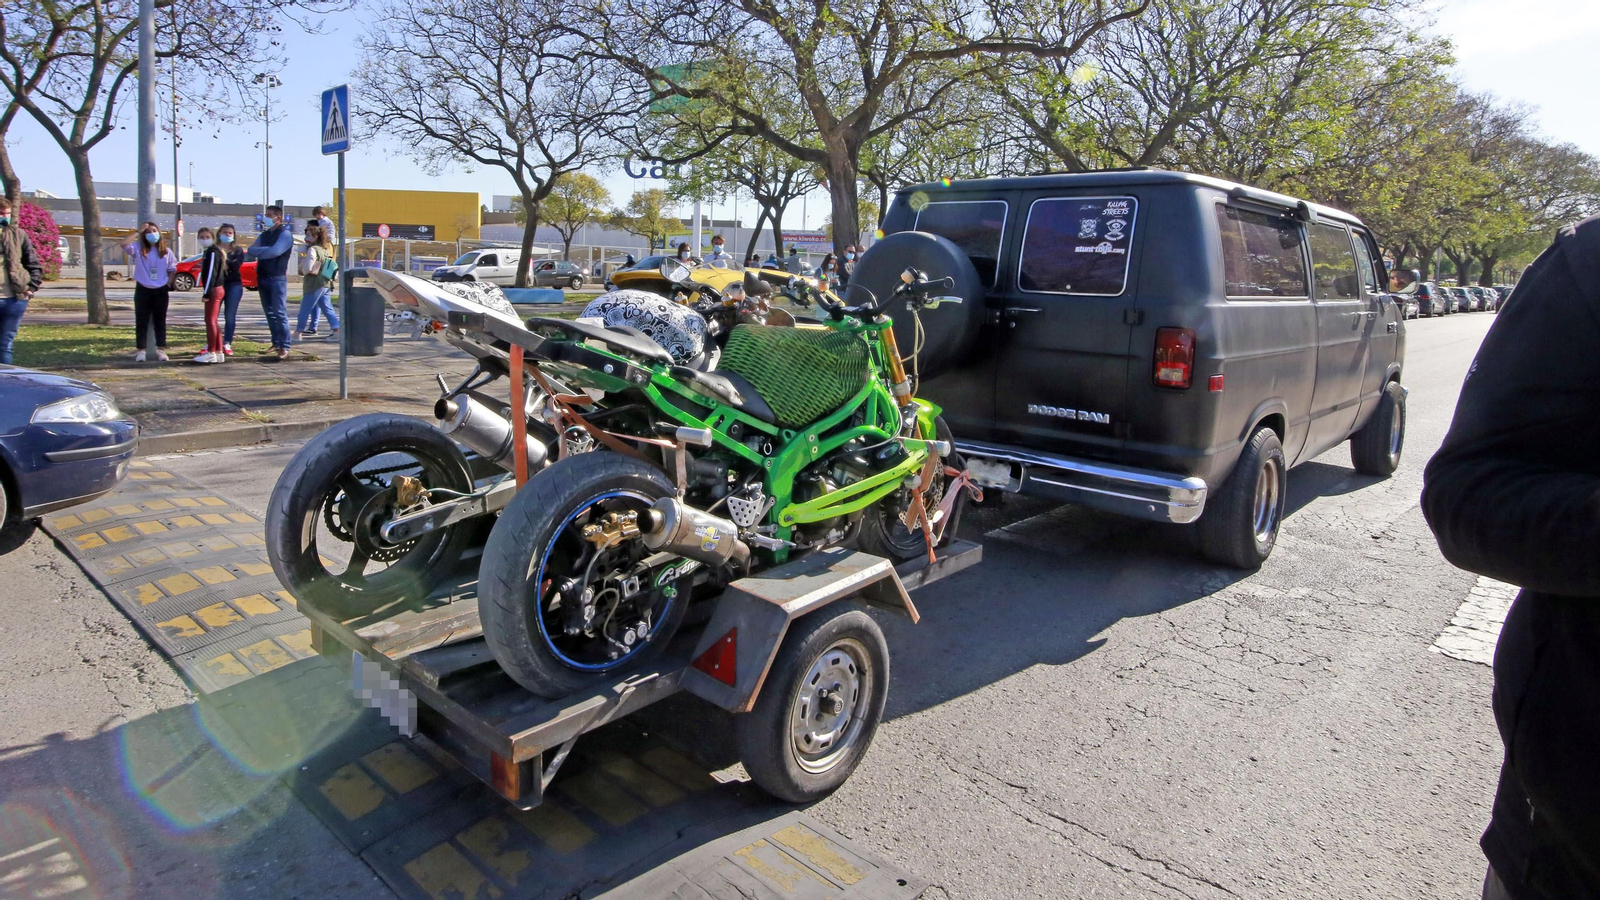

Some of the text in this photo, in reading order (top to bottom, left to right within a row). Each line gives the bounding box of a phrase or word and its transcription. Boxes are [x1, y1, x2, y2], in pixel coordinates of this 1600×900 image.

[1102, 207, 1130, 216] STREETS
[1028, 404, 1109, 424] DODGE RAM
